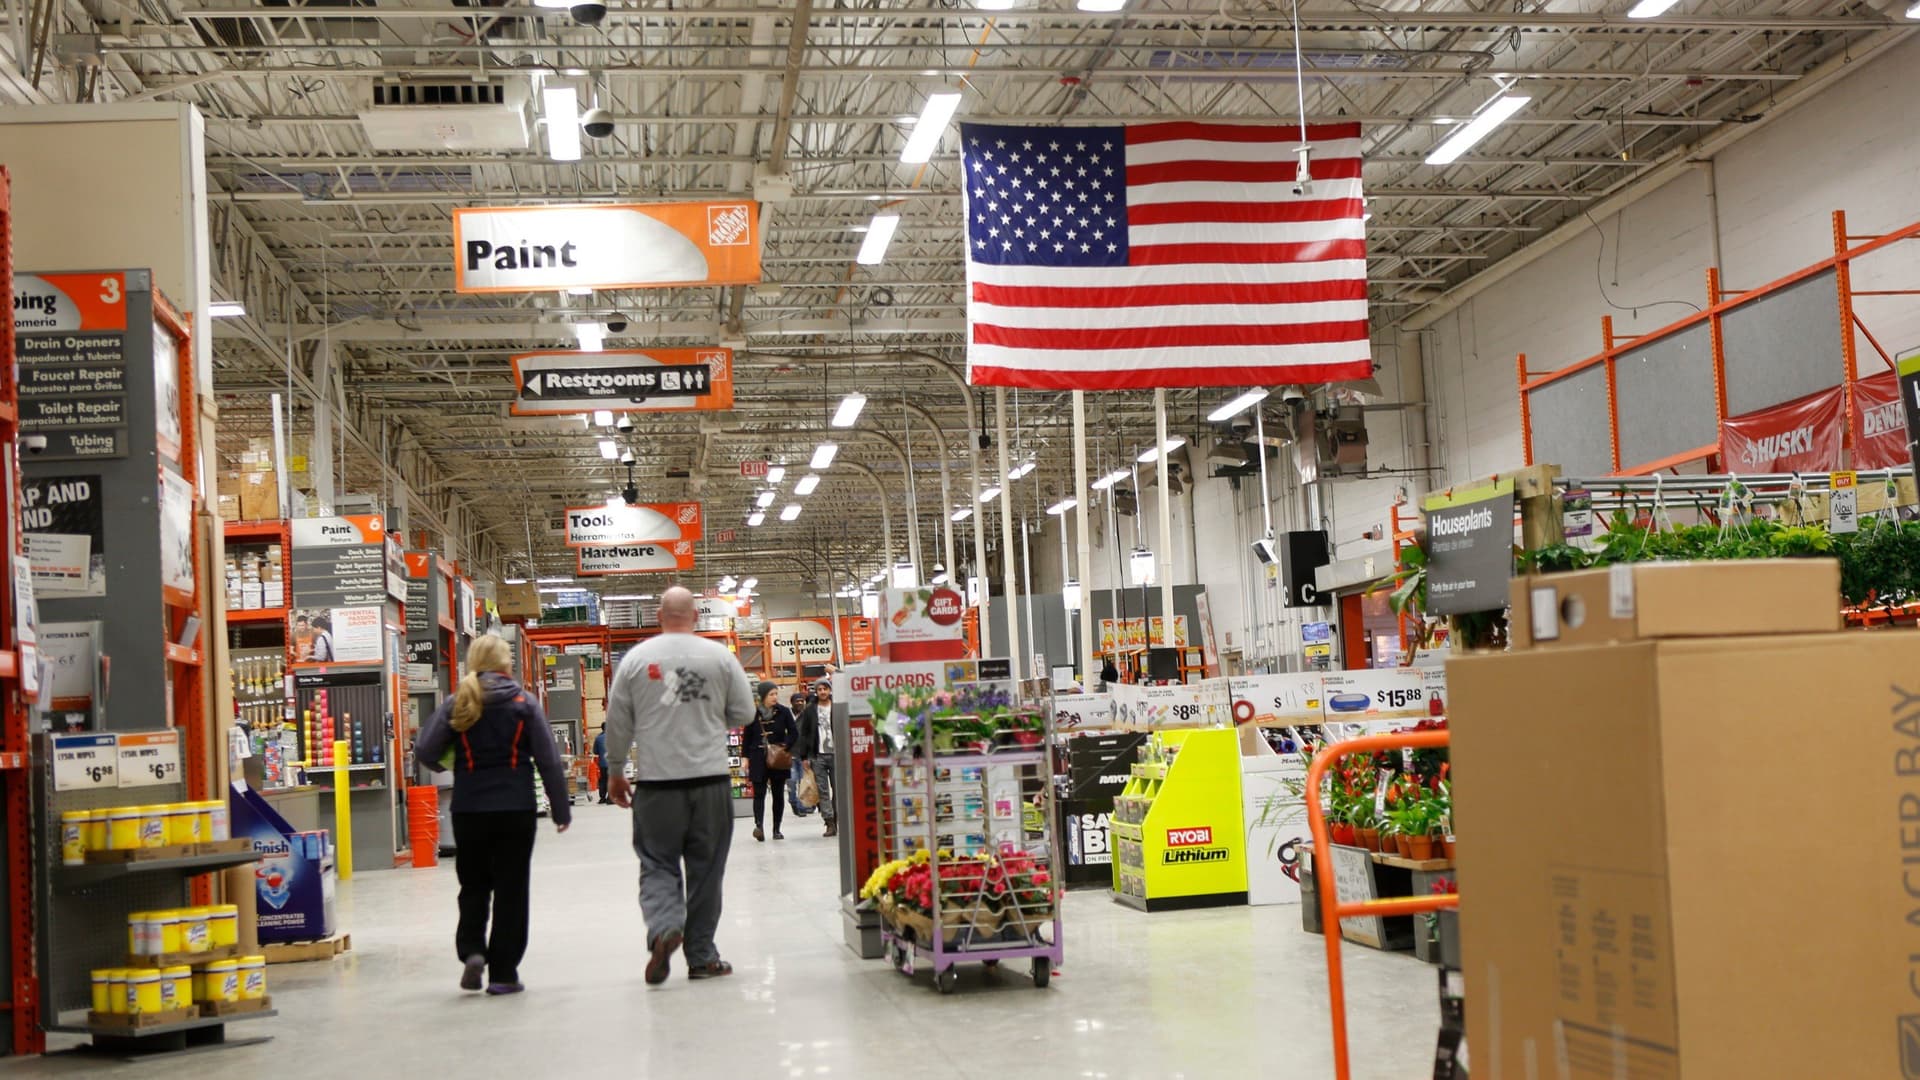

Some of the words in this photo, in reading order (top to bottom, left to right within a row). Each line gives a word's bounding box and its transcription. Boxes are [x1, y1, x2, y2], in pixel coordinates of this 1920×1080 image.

[711, 206, 747, 243] HOME
[467, 239, 577, 271] Paint
[100, 278, 120, 304] 3
[24, 338, 60, 350] Drain
[64, 337, 120, 351] Openers
[33, 370, 75, 382] Faucet
[79, 367, 122, 382] Repair
[546, 372, 656, 389] Restrooms
[38, 402, 73, 415] Toilet
[77, 400, 120, 416] Repair
[70, 434, 114, 448] Tubing
[1757, 424, 1814, 462] HUSKY
[744, 462, 764, 474] EXIT
[48, 482, 90, 504] AND
[369, 518, 380, 532] 6
[570, 514, 614, 528] Tools
[1432, 507, 1492, 536] Houseplants
[322, 524, 352, 534] Paint
[581, 546, 655, 559] Hardware
[417, 556, 428, 568] 7
[1302, 584, 1316, 604] C
[934, 598, 952, 607] GIFT
[930, 606, 958, 616] CARDS
[414, 642, 432, 652] AND
[774, 638, 831, 647] Conractor
[789, 647, 831, 655] Srvices
[851, 676, 882, 692] GIFT
[885, 672, 935, 690] CARDS
[852, 744, 870, 754] GIFT
[1168, 832, 1210, 844] RYOBI
[254, 840, 289, 854] finish
[1164, 850, 1226, 863] Lithium
